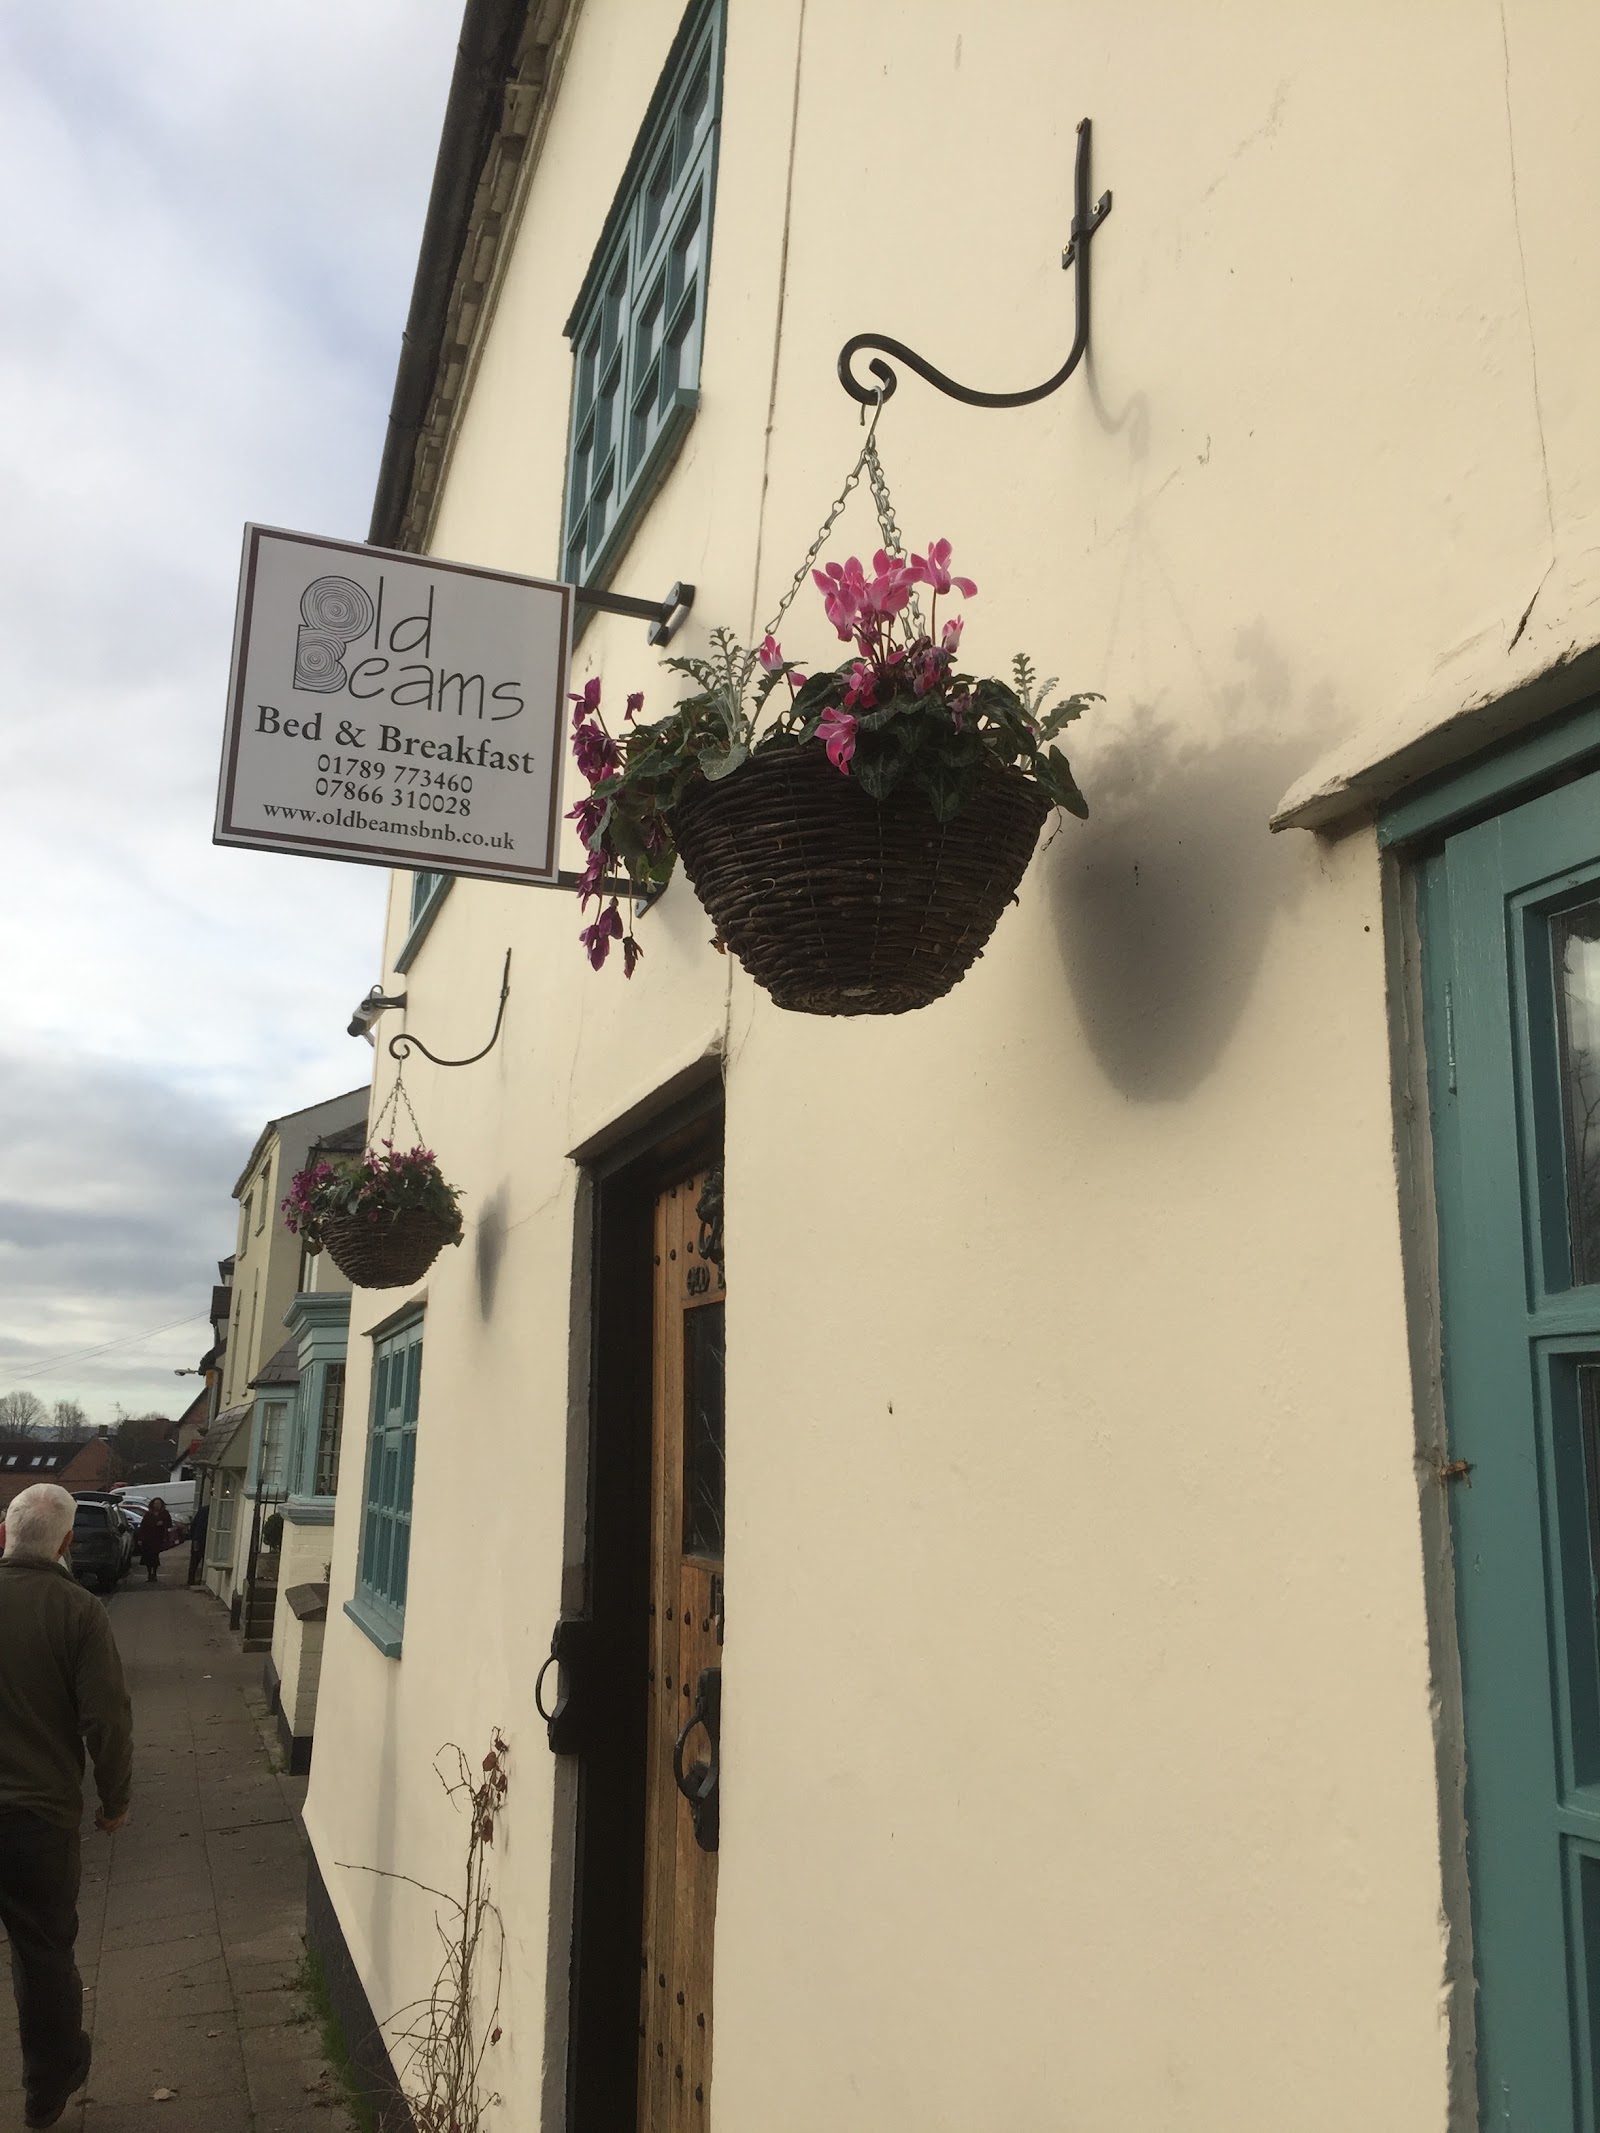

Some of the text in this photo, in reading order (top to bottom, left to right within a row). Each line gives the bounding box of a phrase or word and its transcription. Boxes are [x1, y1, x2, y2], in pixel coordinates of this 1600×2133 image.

[300, 575, 434, 659] Old
[292, 623, 525, 721] Beams
[254, 704, 535, 774] Bed & Breakfast
[315, 777, 471, 817] 07866 310028
[317, 753, 473, 793] 01789 773460
[262, 803, 515, 850] www.oldbeamsbnb.co.uk
